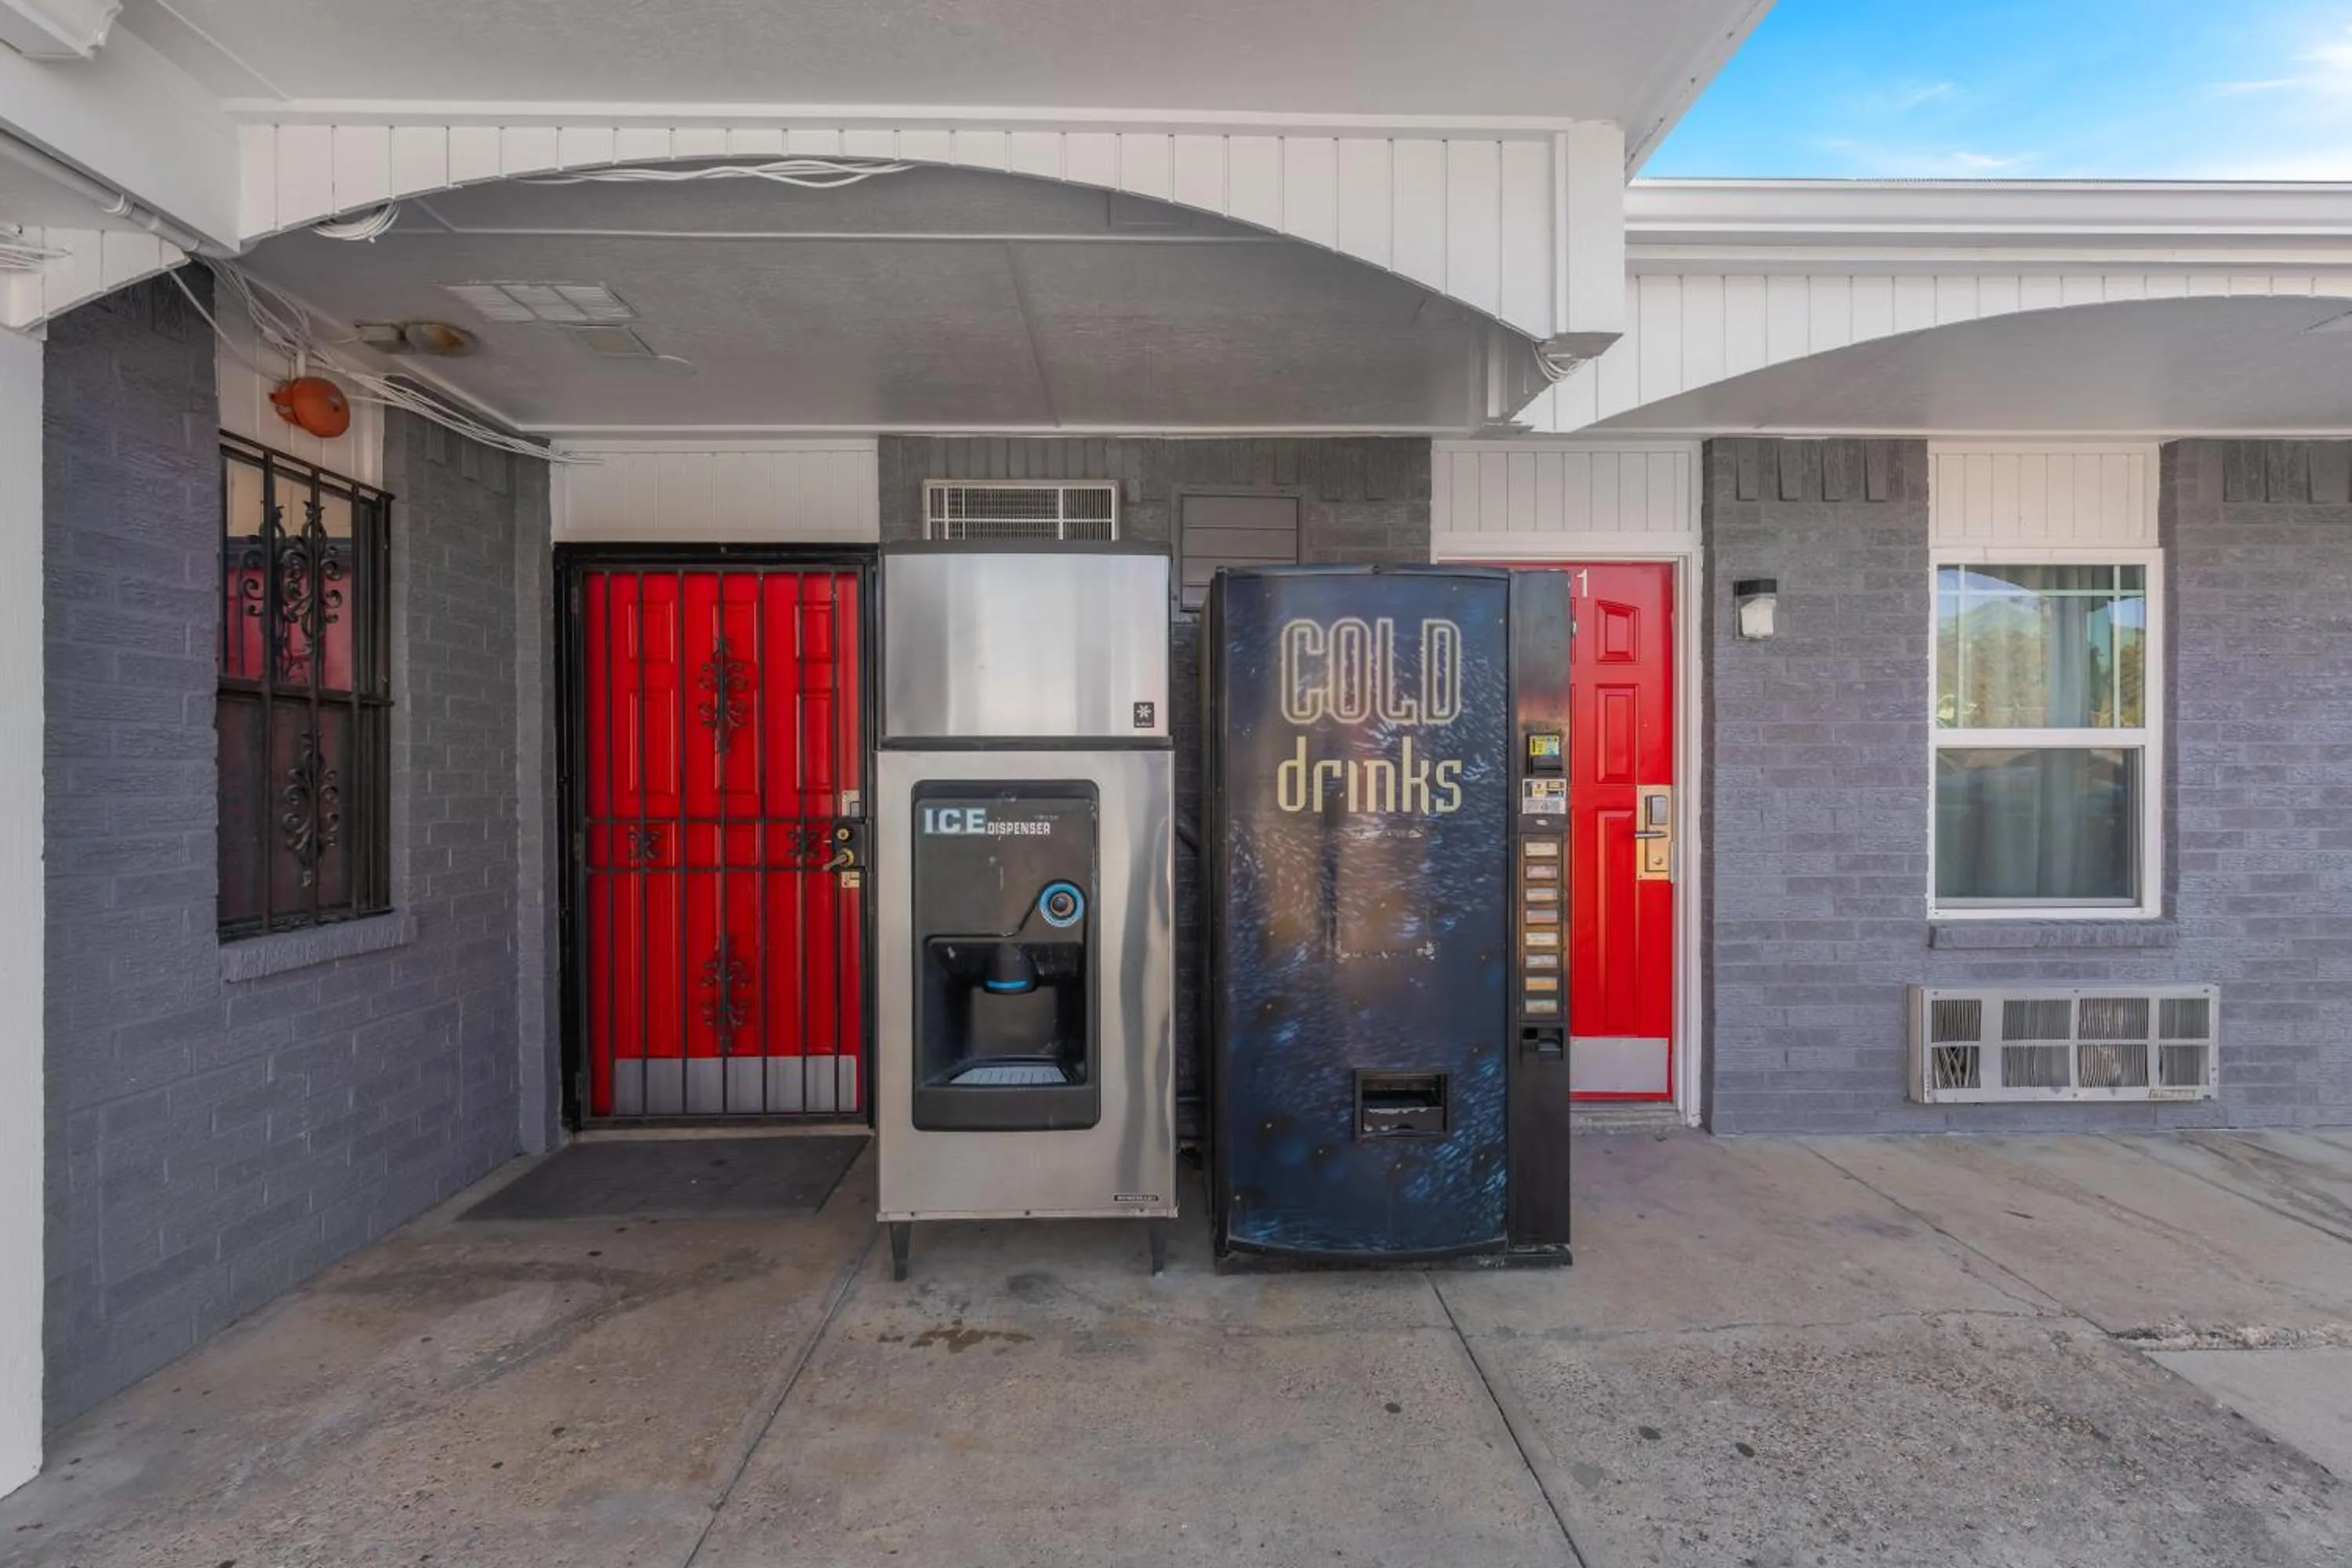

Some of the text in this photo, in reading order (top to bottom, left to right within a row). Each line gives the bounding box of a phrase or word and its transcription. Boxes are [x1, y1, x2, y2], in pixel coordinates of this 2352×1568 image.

[1577, 568, 1588, 597] 1
[1281, 618, 1461, 724] COLD
[1277, 735, 1462, 815] drinks
[924, 808, 1051, 835] ICE DISPENSER
